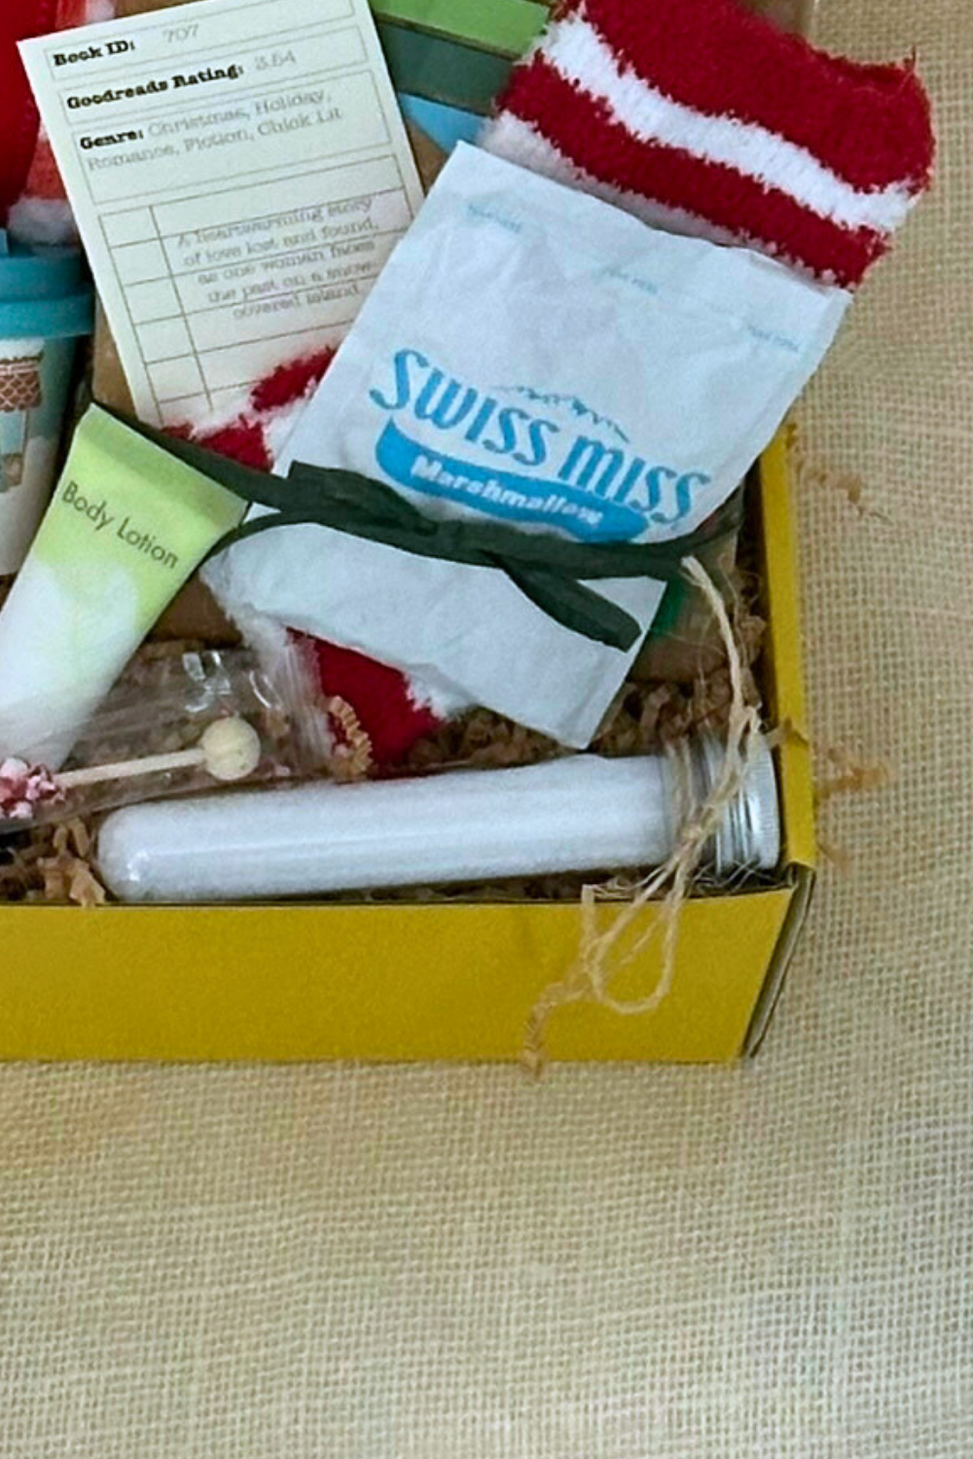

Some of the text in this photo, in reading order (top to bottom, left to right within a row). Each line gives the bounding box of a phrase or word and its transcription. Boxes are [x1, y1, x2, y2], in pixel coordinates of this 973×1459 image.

[52, 24, 199, 66] Book ID: 707
[66, 79, 169, 110] Goodreads
[172, 63, 244, 90] Rating:
[79, 88, 332, 150] Genre: Christmas, Holiday,
[86, 105, 342, 171] Romance, Fiction, Chick Lit
[184, 252, 201, 267] of
[262, 251, 324, 274] woman
[369, 348, 560, 466] SWISS
[410, 454, 604, 528] Marshmallow
[61, 481, 180, 570] Body Lotion
